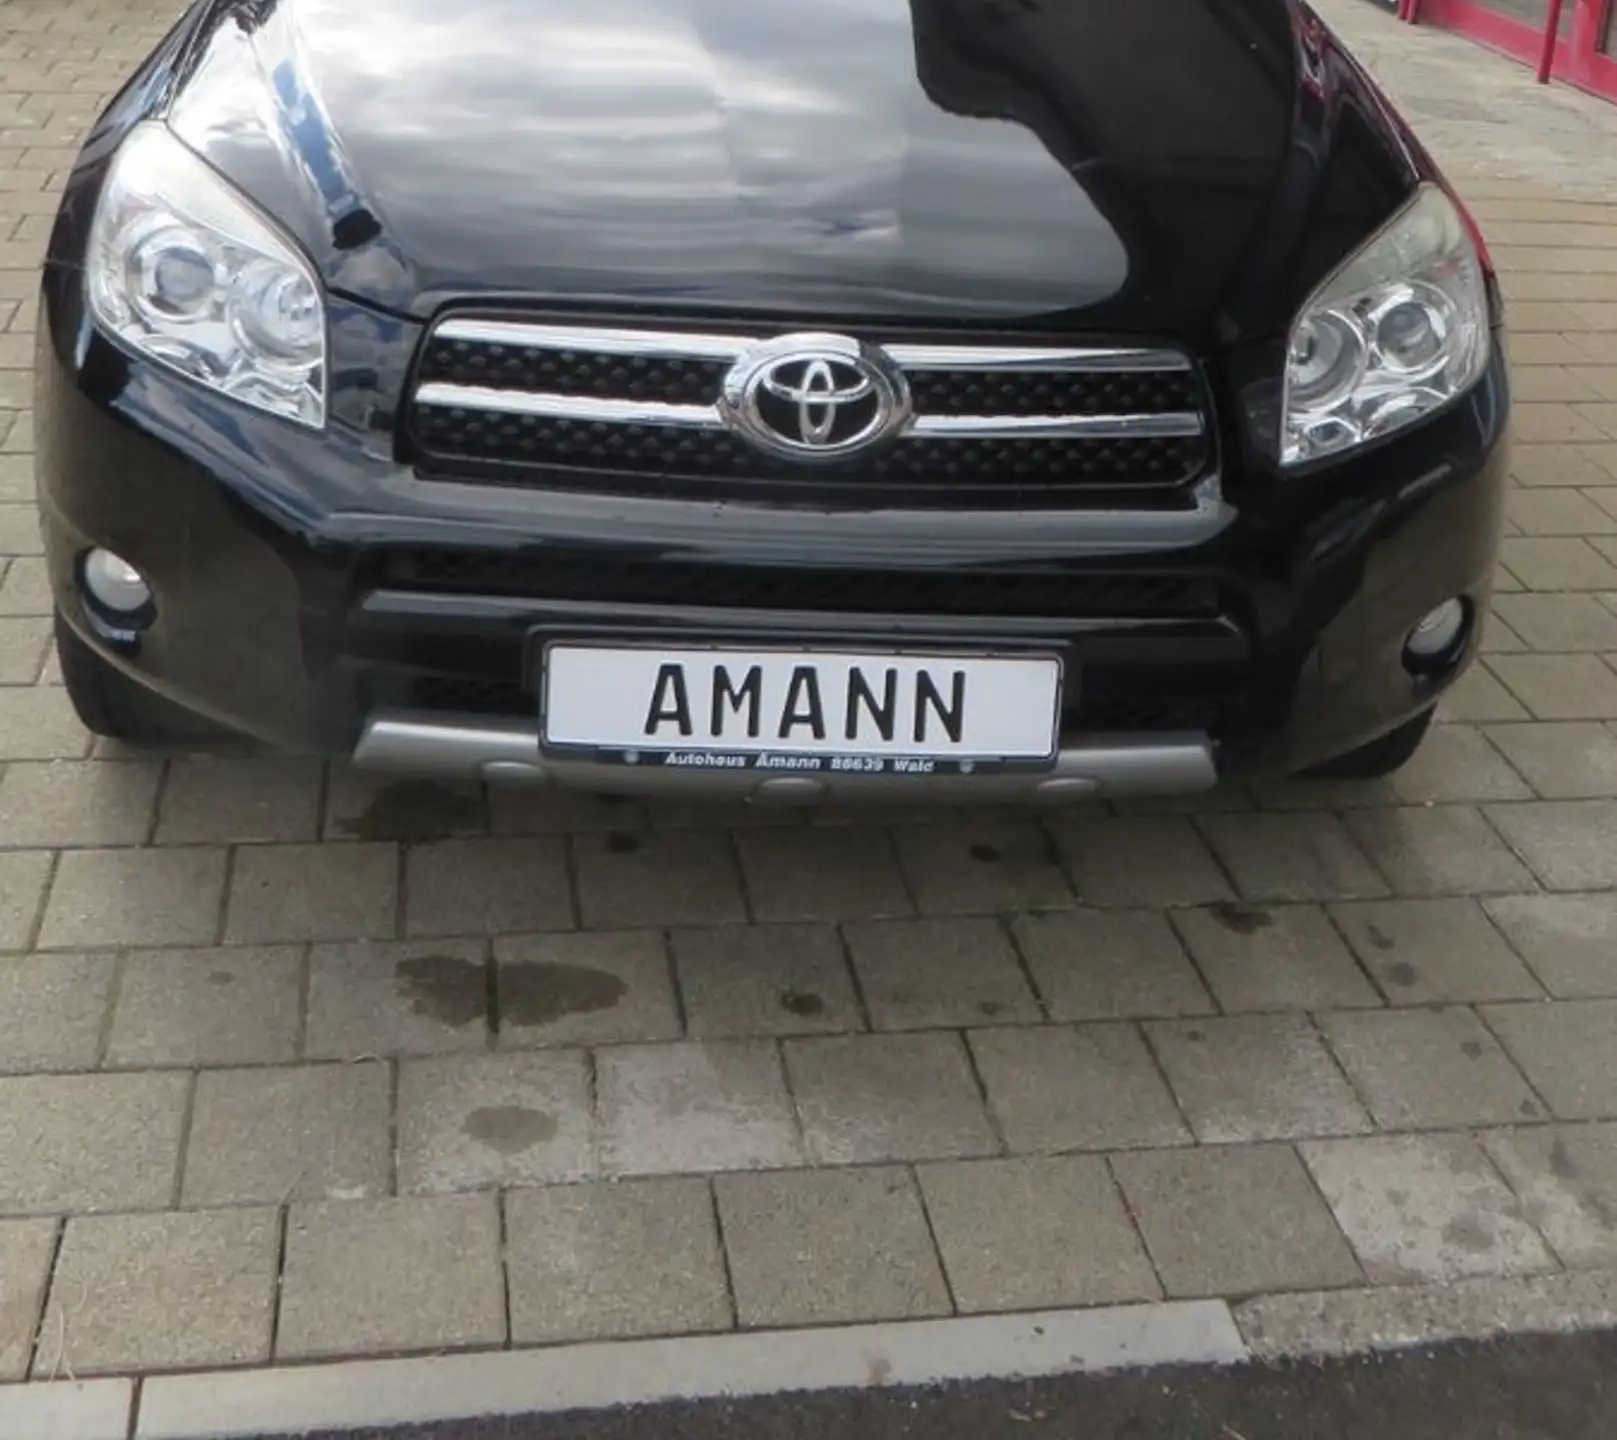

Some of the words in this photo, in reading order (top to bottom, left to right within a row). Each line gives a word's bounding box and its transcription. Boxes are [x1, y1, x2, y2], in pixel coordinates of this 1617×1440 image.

[644, 662, 966, 743] AMANN
[665, 751, 746, 767] Autohaus
[894, 759, 934, 773] Wald
